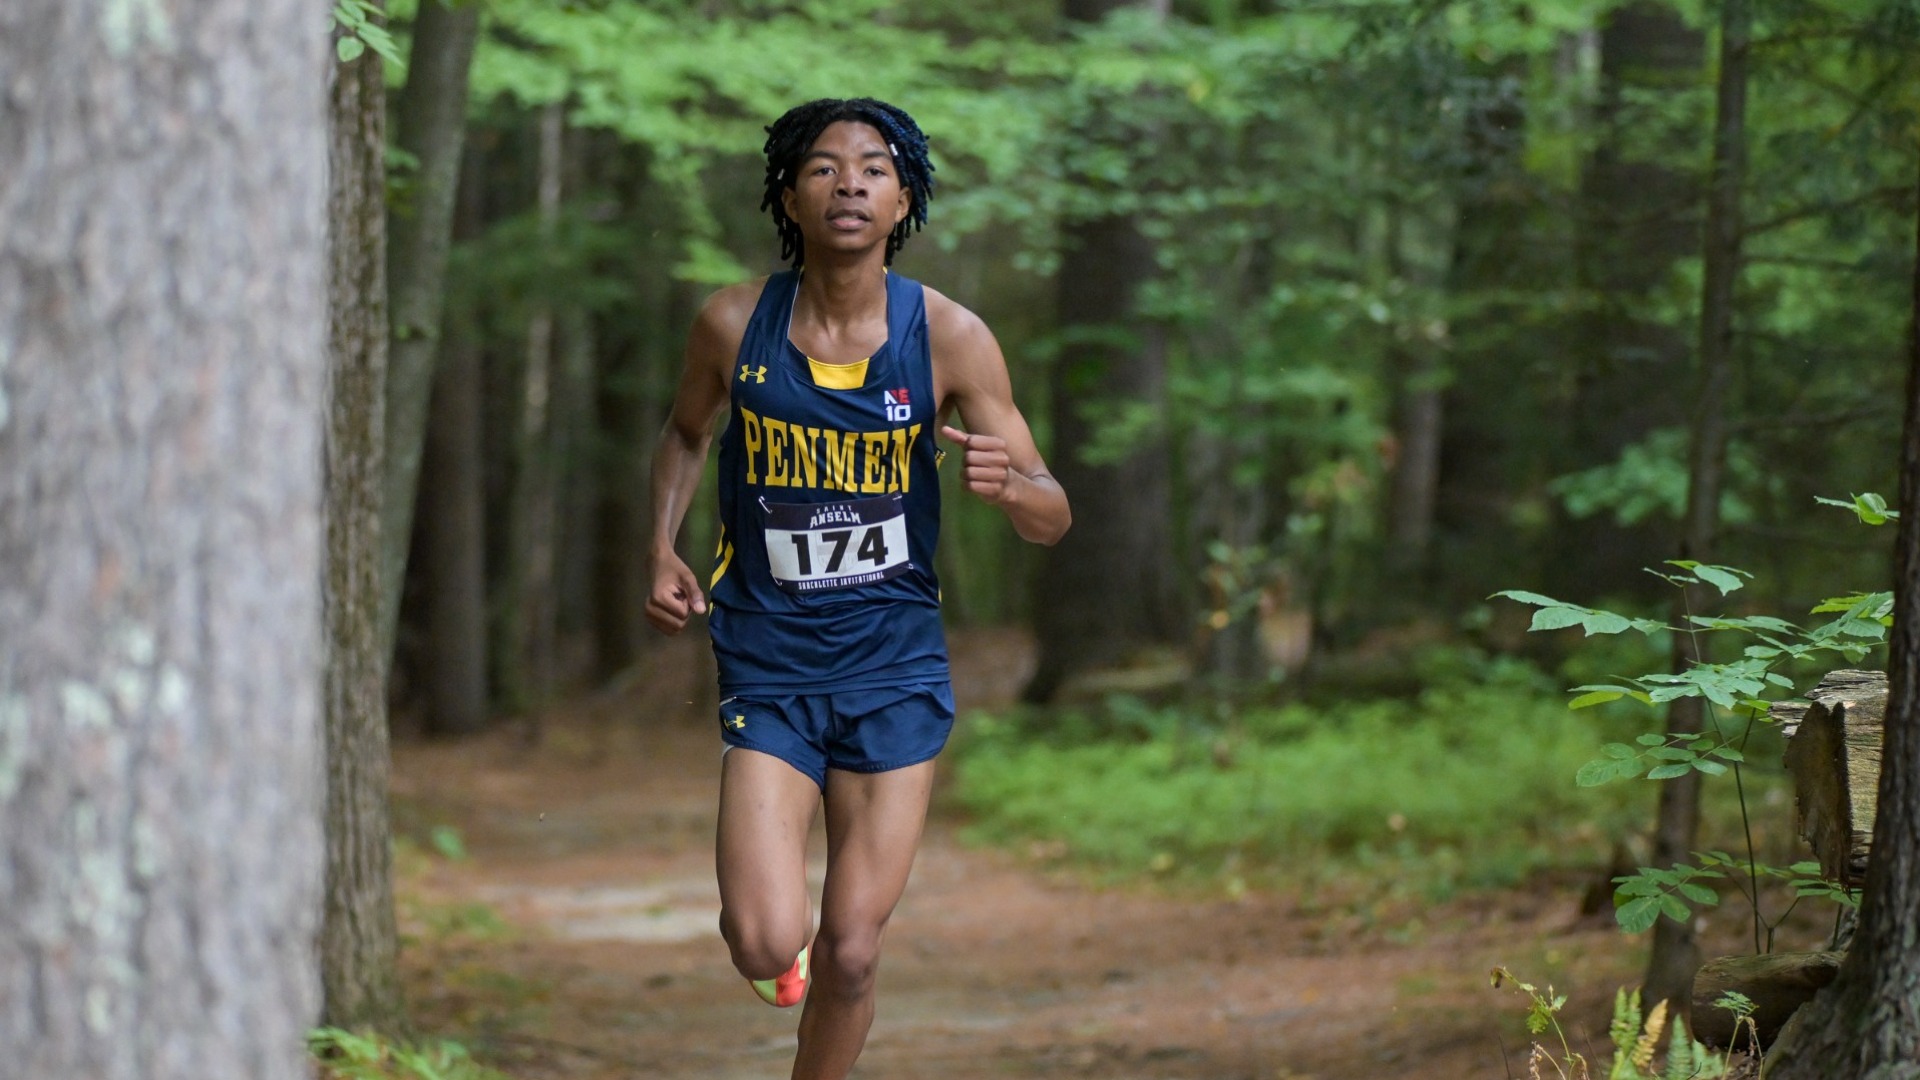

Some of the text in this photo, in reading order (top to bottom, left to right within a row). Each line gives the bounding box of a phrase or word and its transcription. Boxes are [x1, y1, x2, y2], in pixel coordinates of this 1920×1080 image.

[886, 405, 911, 421] 10
[741, 407, 921, 493] PENMEN
[816, 504, 852, 514] SAINT
[809, 511, 862, 529] ANSELM
[791, 525, 889, 576] 174
[840, 571, 885, 586] INVITATIONAL
